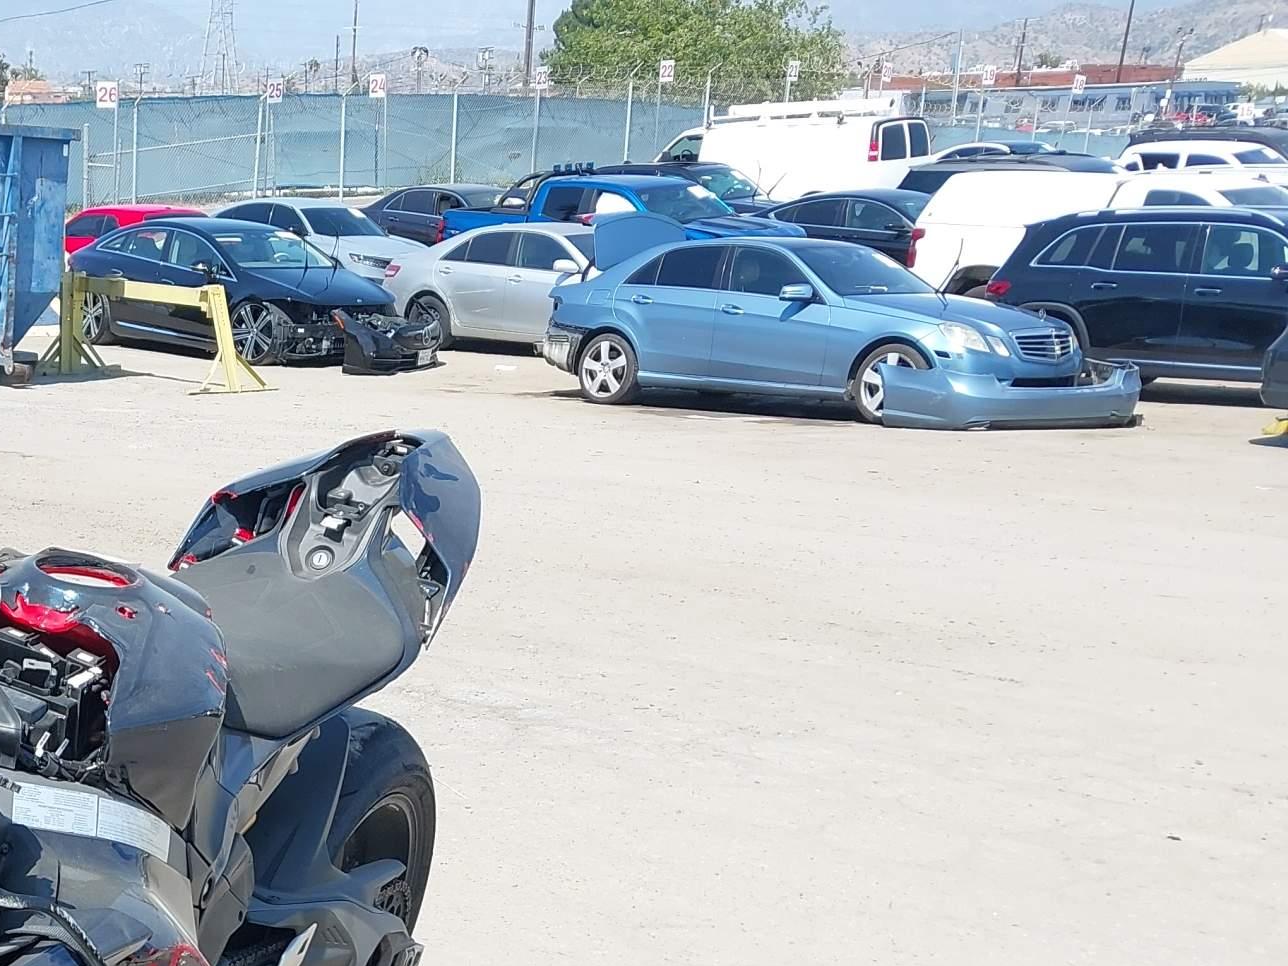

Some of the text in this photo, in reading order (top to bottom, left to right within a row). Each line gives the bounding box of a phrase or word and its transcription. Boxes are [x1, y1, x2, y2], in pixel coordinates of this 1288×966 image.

[661, 64, 673, 77] 22
[788, 64, 797, 77] 21
[983, 70, 995, 81] 19
[537, 71, 547, 85] 23
[1074, 78, 1085, 91] 18
[268, 82, 282, 98] 25
[371, 78, 385, 93] 24
[98, 87, 117, 102] 26
